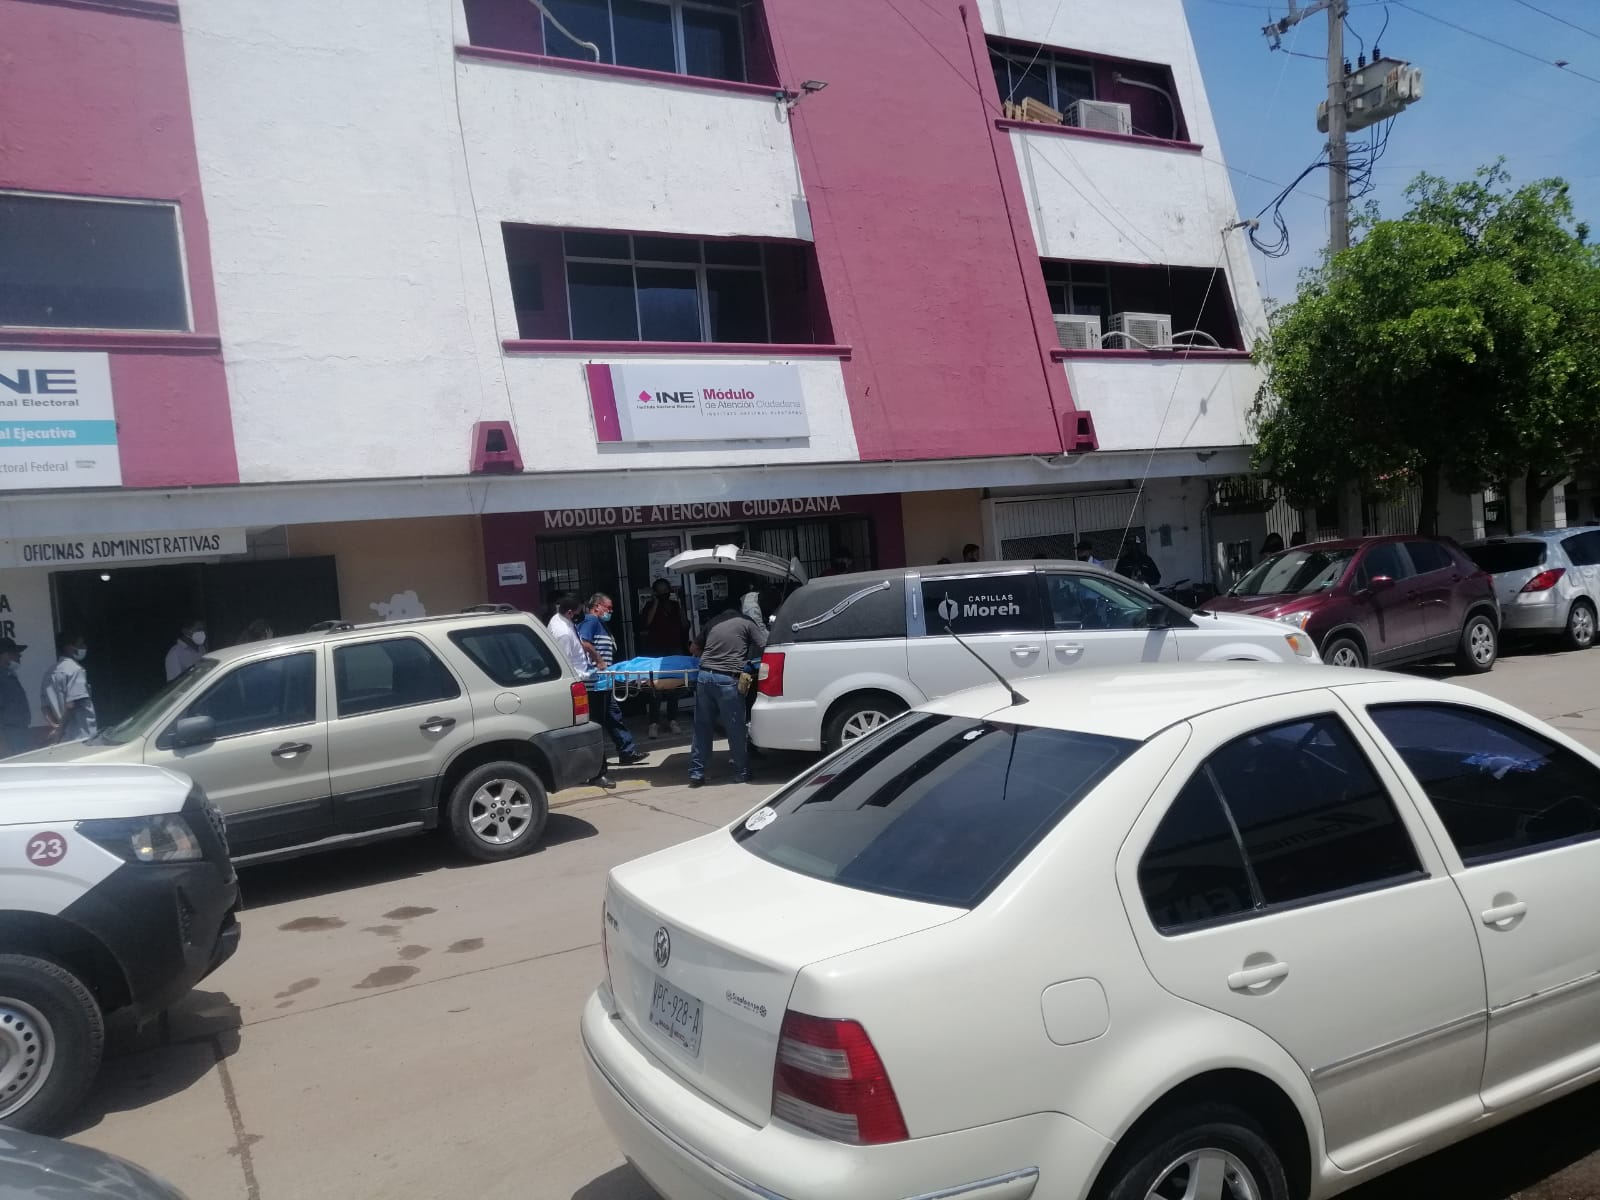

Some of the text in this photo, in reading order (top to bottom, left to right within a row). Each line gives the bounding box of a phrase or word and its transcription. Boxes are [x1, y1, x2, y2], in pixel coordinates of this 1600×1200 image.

[656, 391, 695, 404] INE
[702, 388, 755, 400] Módulo
[22, 398, 79, 407] Electoral
[13, 426, 77, 442] Ejecutiva
[30, 460, 69, 472] Federal
[544, 506, 617, 528] MODULO
[622, 506, 643, 524] DE
[742, 495, 841, 516] CIUDADANA
[23, 535, 220, 562] OFICINAS ADMINISTRATIVAS
[968, 594, 1014, 602] CAPILLAS
[963, 603, 1020, 617] Moreh
[0, 620, 16, 639] R
[31, 839, 62, 860] 23
